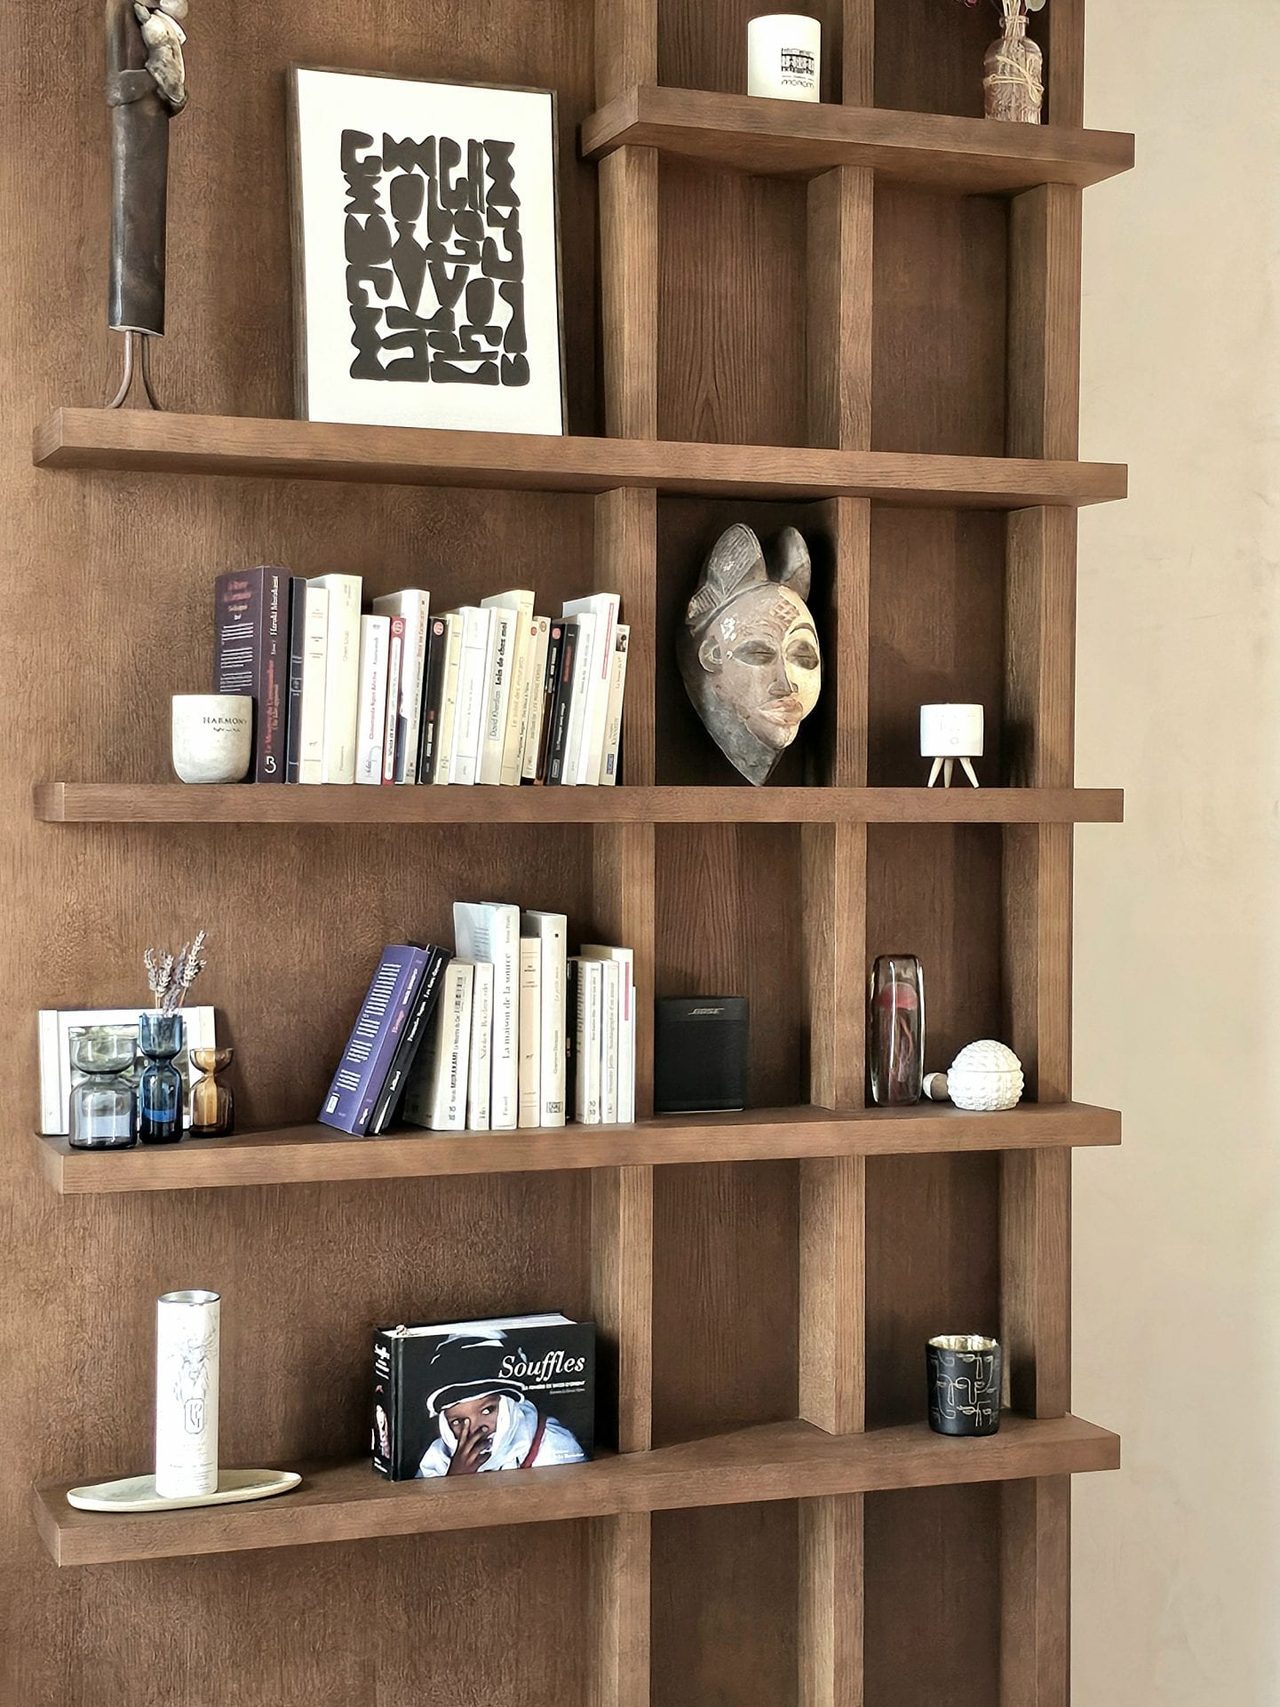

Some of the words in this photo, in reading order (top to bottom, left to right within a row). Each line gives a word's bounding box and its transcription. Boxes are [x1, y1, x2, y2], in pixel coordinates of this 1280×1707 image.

[502, 985, 511, 994] la
[502, 998, 511, 1009] de
[503, 1012, 511, 1045] maison
[502, 1047, 510, 1059] La
[498, 1349, 586, 1382] Souffles
